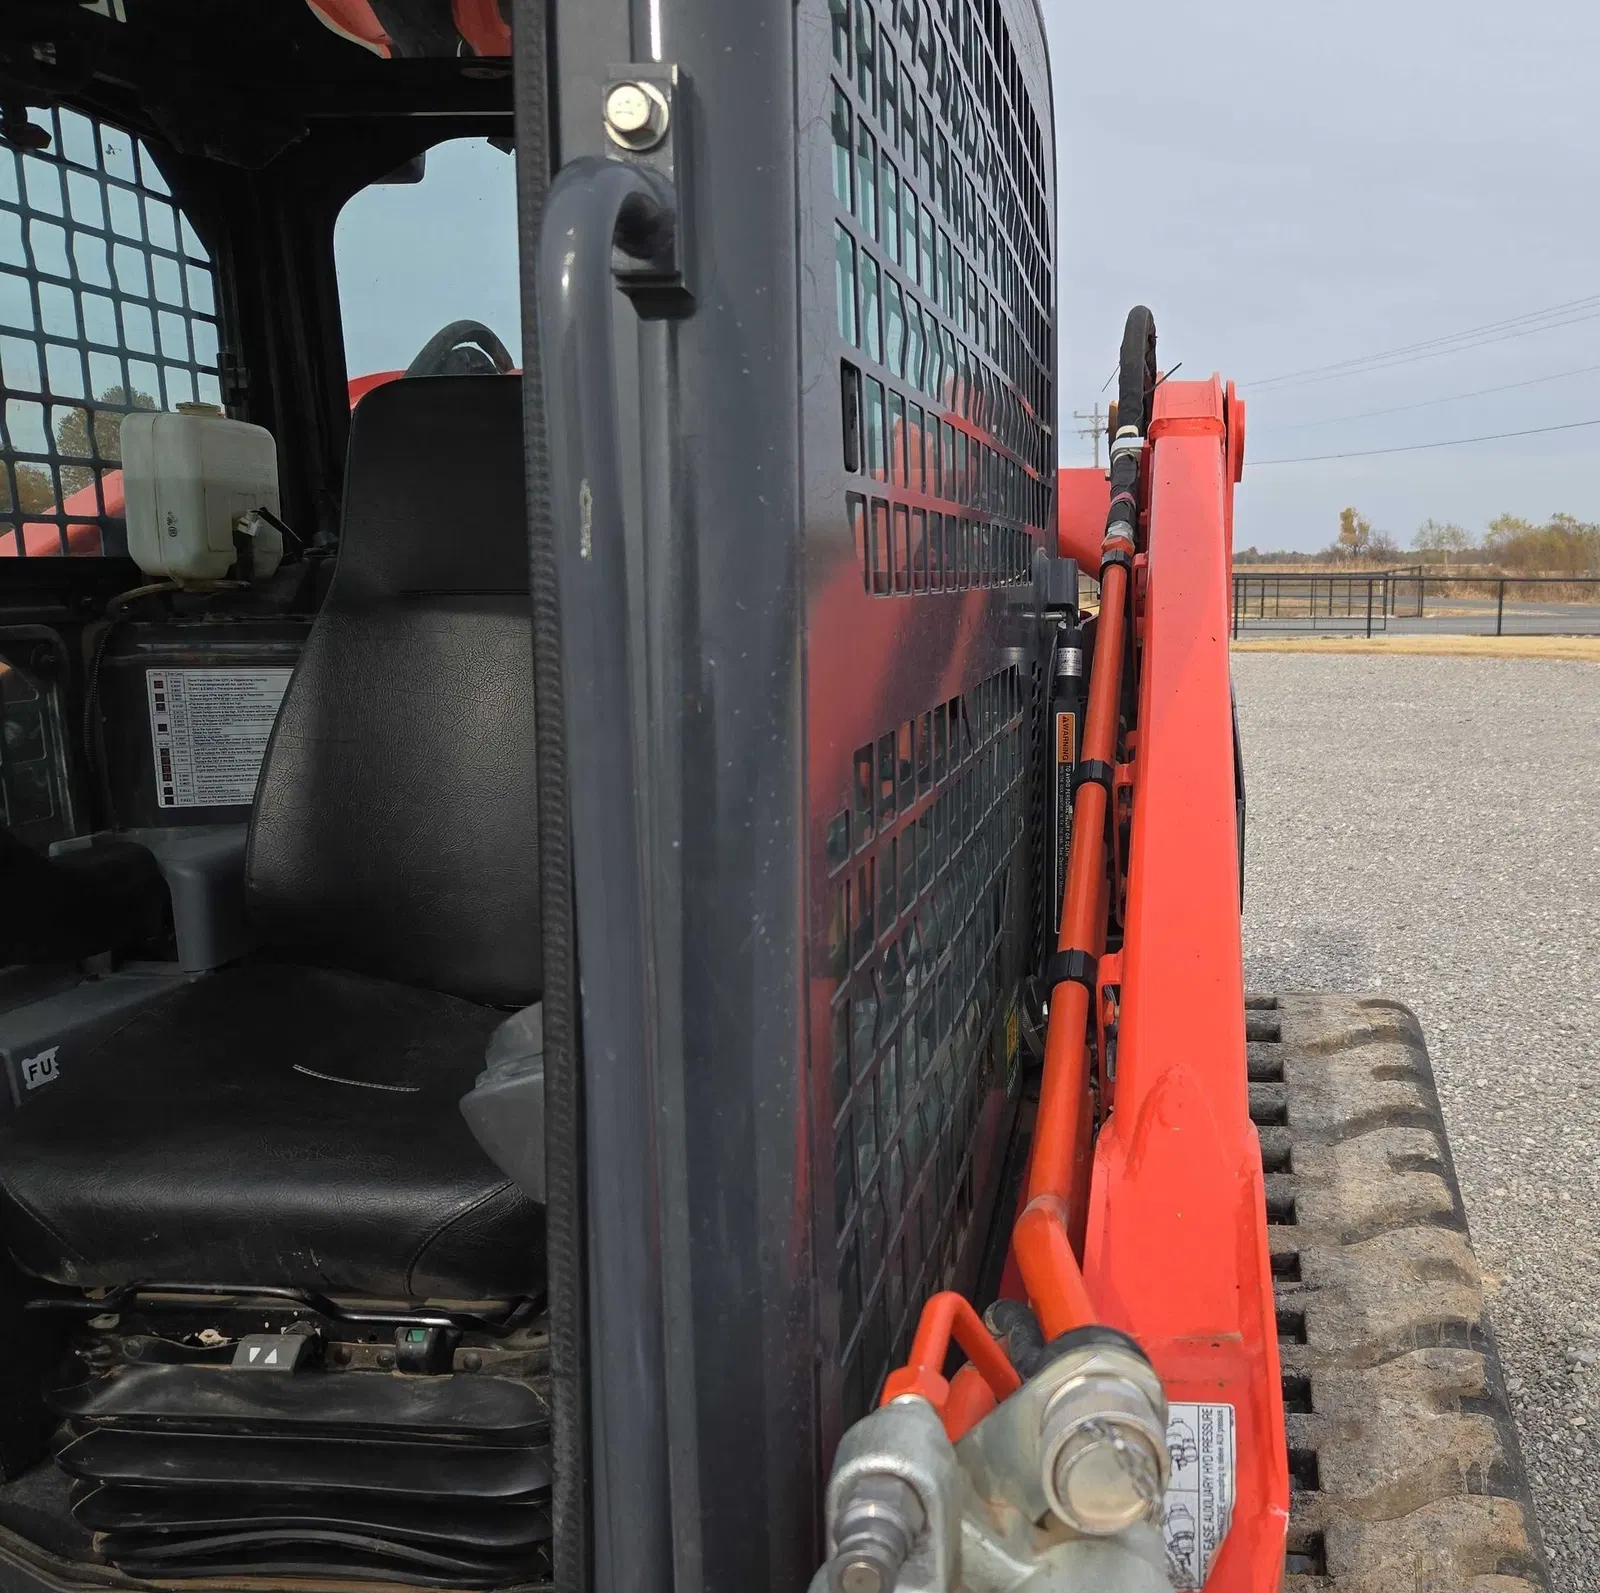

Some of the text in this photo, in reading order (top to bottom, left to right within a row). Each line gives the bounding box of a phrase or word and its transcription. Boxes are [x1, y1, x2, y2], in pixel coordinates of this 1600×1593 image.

[1202, 1408, 1213, 1453] PRESSURE
[1202, 1455, 1213, 1474] HYD
[1202, 1475, 1214, 1523] AUXILIARY
